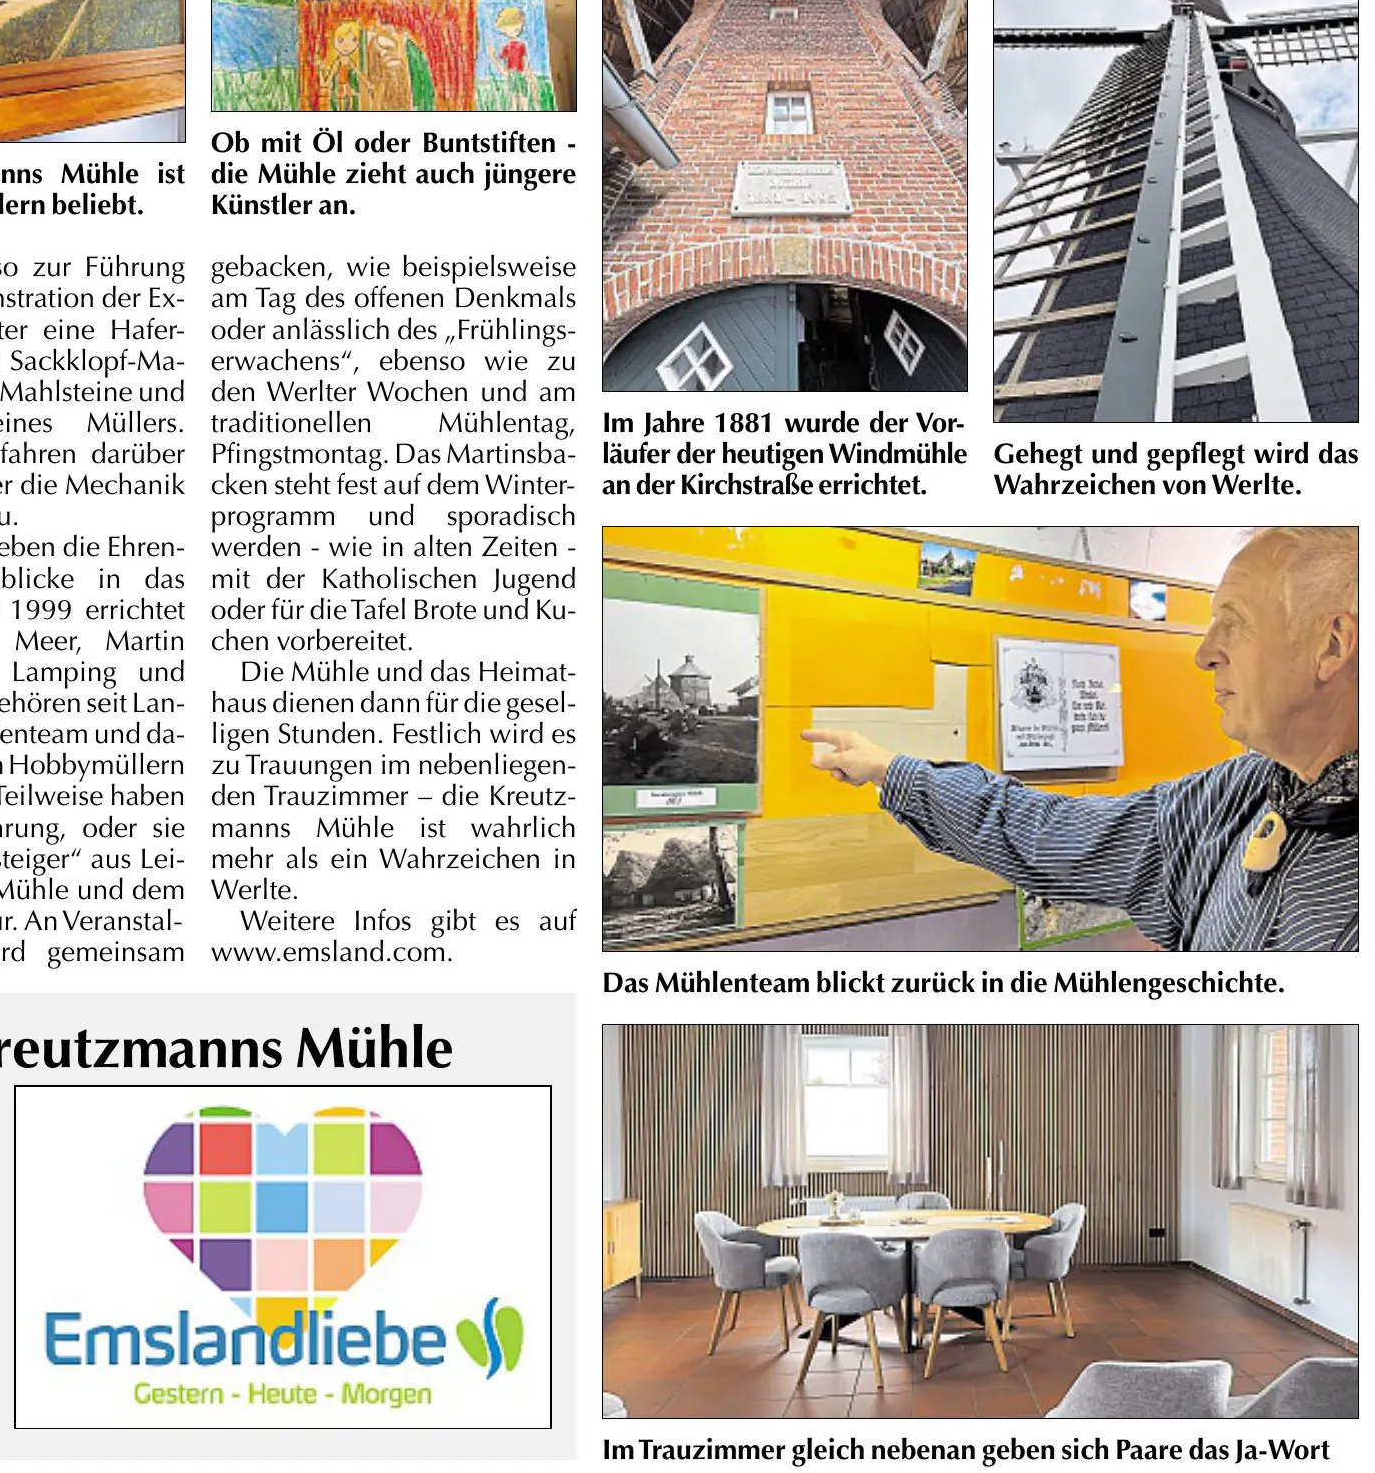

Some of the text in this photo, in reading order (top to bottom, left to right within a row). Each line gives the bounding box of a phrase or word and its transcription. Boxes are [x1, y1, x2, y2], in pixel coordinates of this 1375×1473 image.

[211, 130, 250, 154] Ob
[261, 130, 302, 154] mit
[312, 126, 343, 154] Öl
[354, 130, 411, 154] oder
[423, 130, 556, 154] Buntstiften
[211, 161, 577, 192] die Mühle zieht auch jüngere
[212, 192, 356, 216] Künstler an.
[603, 410, 965, 438] Im Jahre 1881 wurde der Vor-
[603, 441, 968, 472] läufer der heutigen Windmühle
[602, 471, 927, 496] an der Kirchstraße errichtet.
[11, 599, 72, 621] 1999
[85, 597, 186, 621] errichtet
[210, 939, 453, 963] www.emsland.com.
[603, 970, 1285, 1001] Das Mühlenteam blickt zurück in die Mühlengeschichte.
[296, 1023, 453, 1069] Mühle
[46, 1310, 446, 1366] Emslandliebe
[134, 1381, 225, 1405] Gestern
[248, 1382, 318, 1405] Heute
[340, 1381, 432, 1409] Morgen
[603, 1437, 1331, 1468] Im Trauzimmer gleich nebenan geben sich Paare das Ja-Wort
